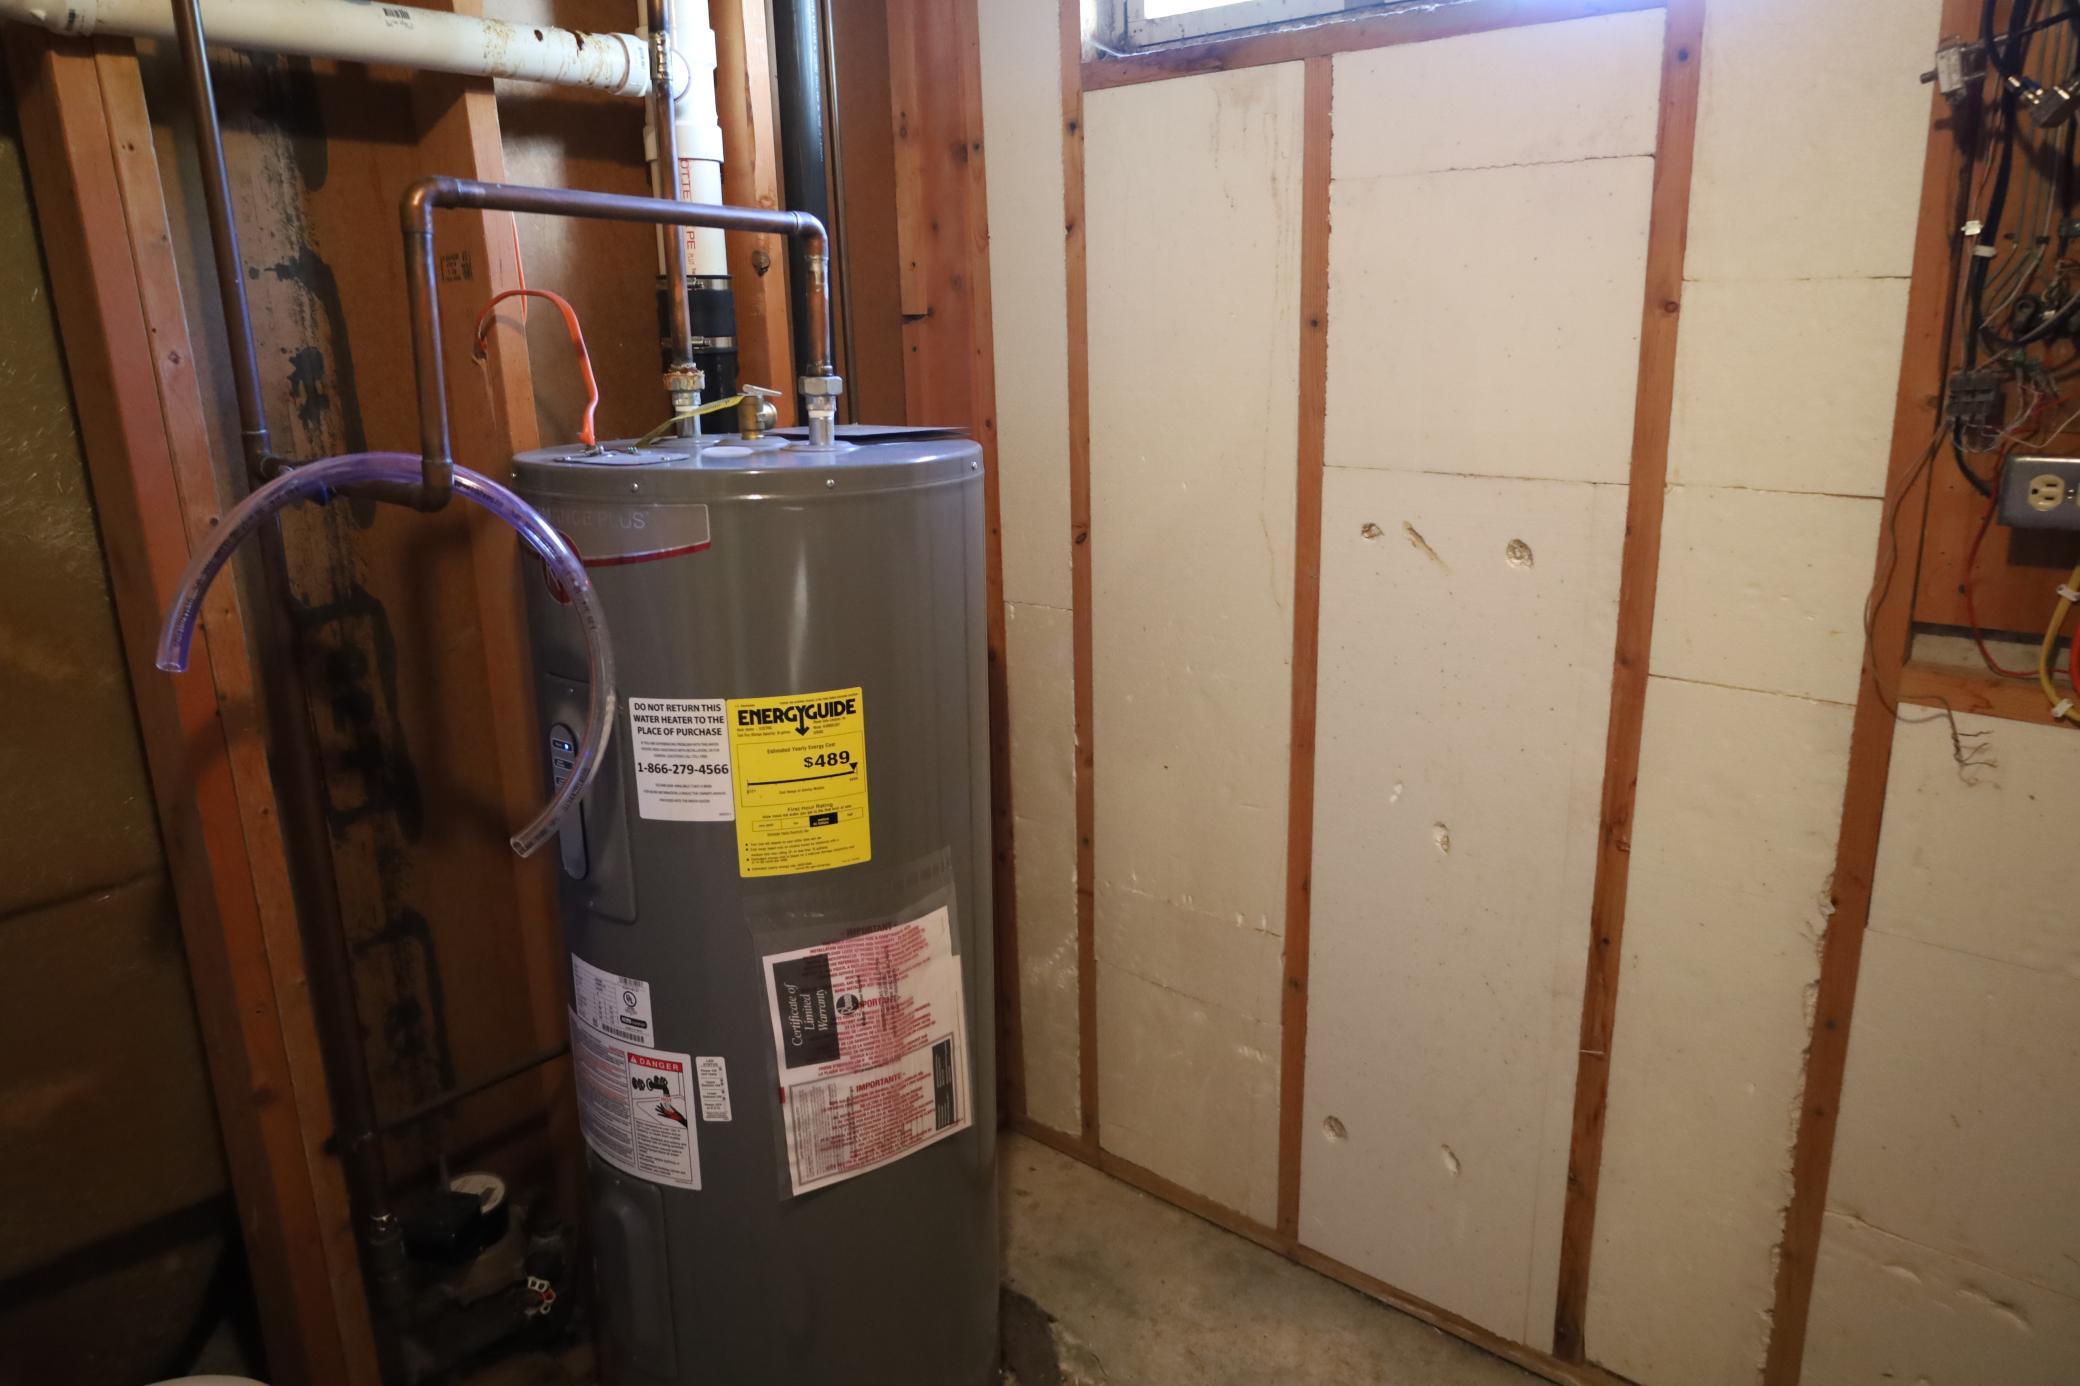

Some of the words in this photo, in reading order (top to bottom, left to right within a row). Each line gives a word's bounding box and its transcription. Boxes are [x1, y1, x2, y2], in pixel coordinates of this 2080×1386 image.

[634, 703, 646, 711] DO
[648, 704, 664, 712] NOT
[666, 704, 700, 712] RETURN
[738, 699, 856, 726] ENERGYGUIDE
[633, 715, 660, 724] WATER
[661, 716, 693, 724] HEATER
[694, 716, 706, 724] TO
[708, 716, 724, 724] THE
[637, 727, 662, 735] PLACE
[676, 728, 722, 736] PURCHASE
[803, 750, 850, 768] $489
[637, 763, 729, 775] 1-866-279-4566
[784, 982, 799, 994] of
[800, 994, 815, 1030] Limited
[816, 989, 828, 1030] Warranty
[788, 996, 803, 1046] Certificate
[639, 1057, 679, 1071] DANGER
